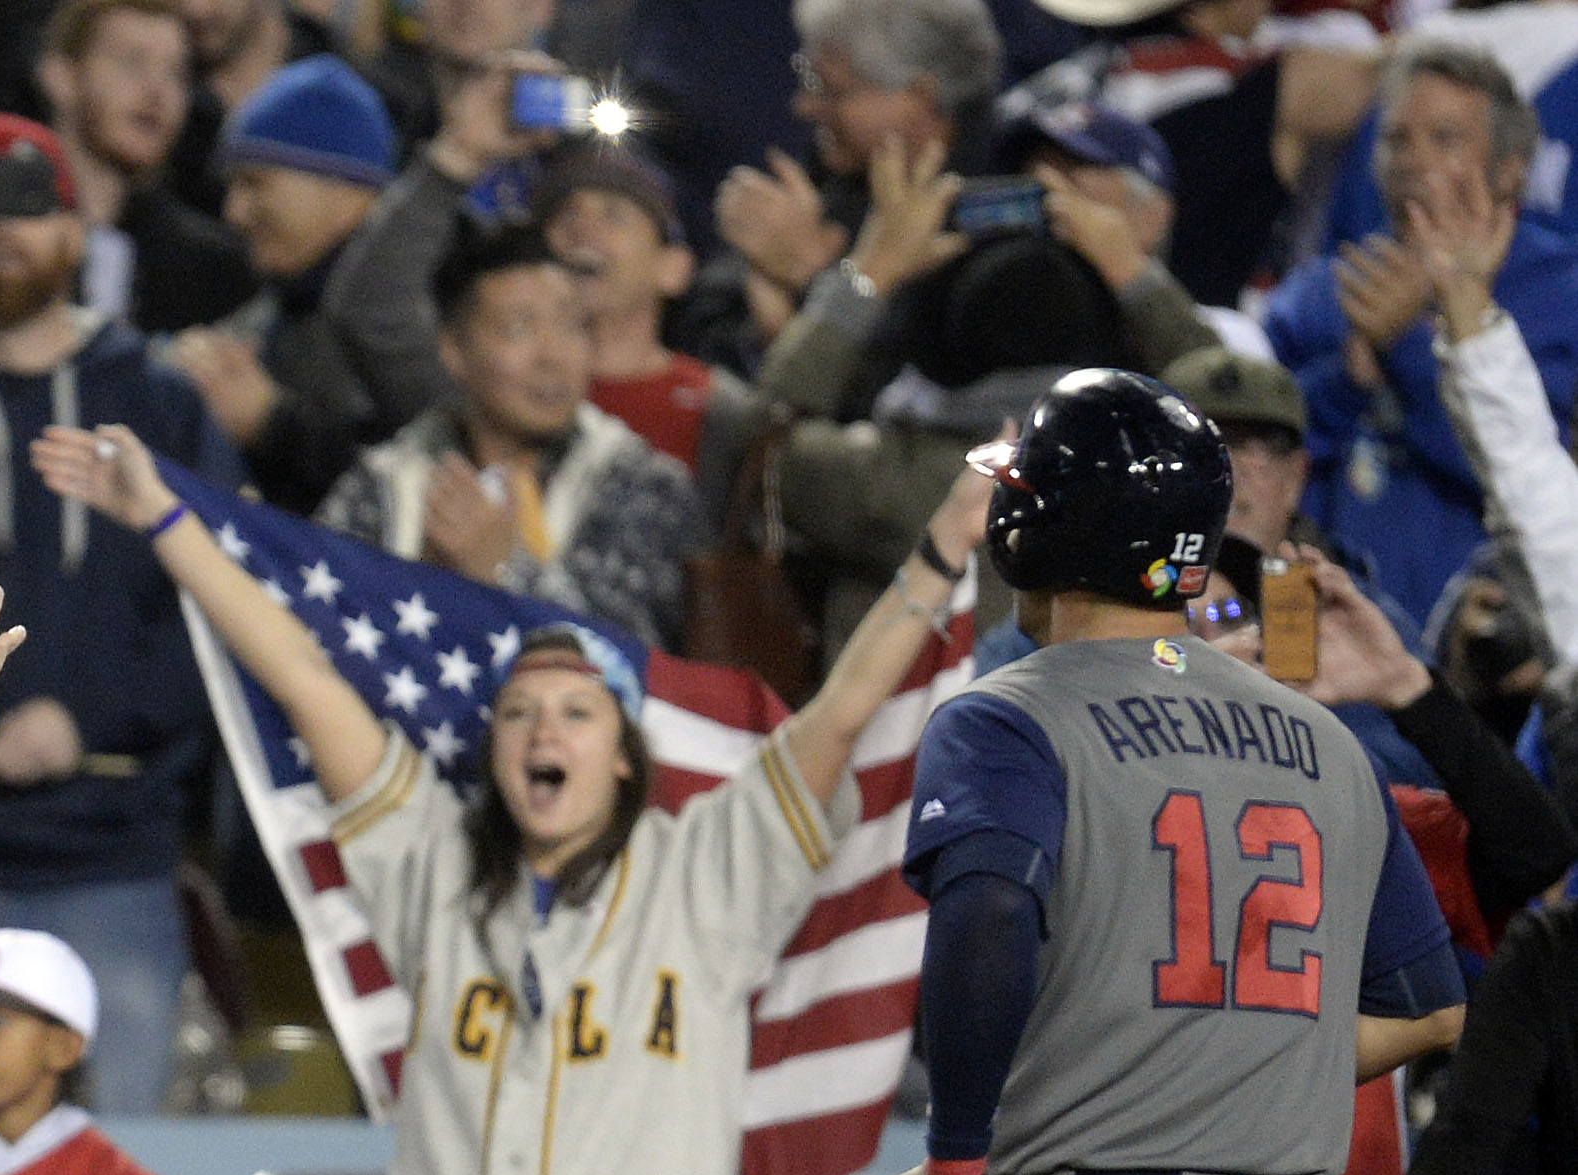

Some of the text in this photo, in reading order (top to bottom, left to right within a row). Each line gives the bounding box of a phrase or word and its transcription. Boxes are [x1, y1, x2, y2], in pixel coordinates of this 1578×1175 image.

[1169, 532, 1205, 562] 12
[1087, 695, 1320, 781] ARENADO
[1151, 787, 1323, 1022] 12
